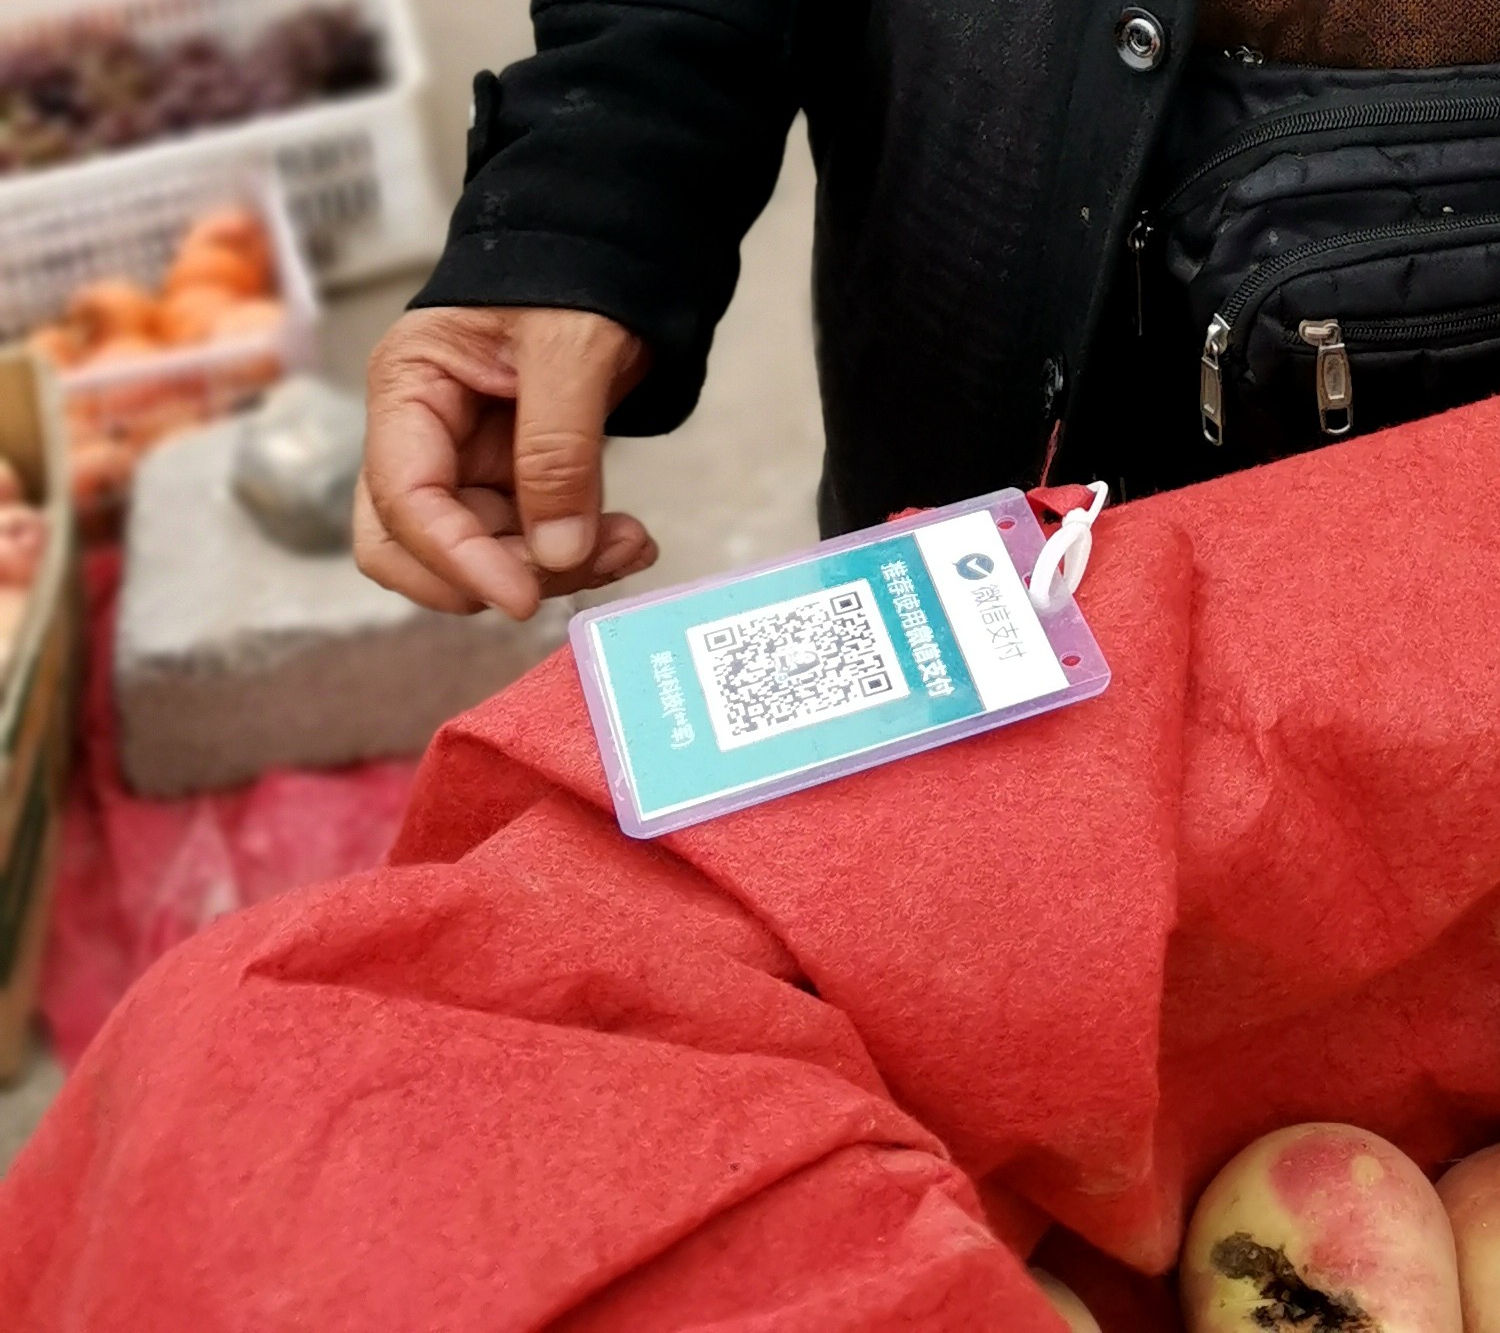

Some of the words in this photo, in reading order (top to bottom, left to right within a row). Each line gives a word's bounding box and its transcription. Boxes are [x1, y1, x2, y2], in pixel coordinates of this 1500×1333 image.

[880, 560, 956, 697] 推荐使用微信支付
[971, 584, 1027, 660] 微信支付
